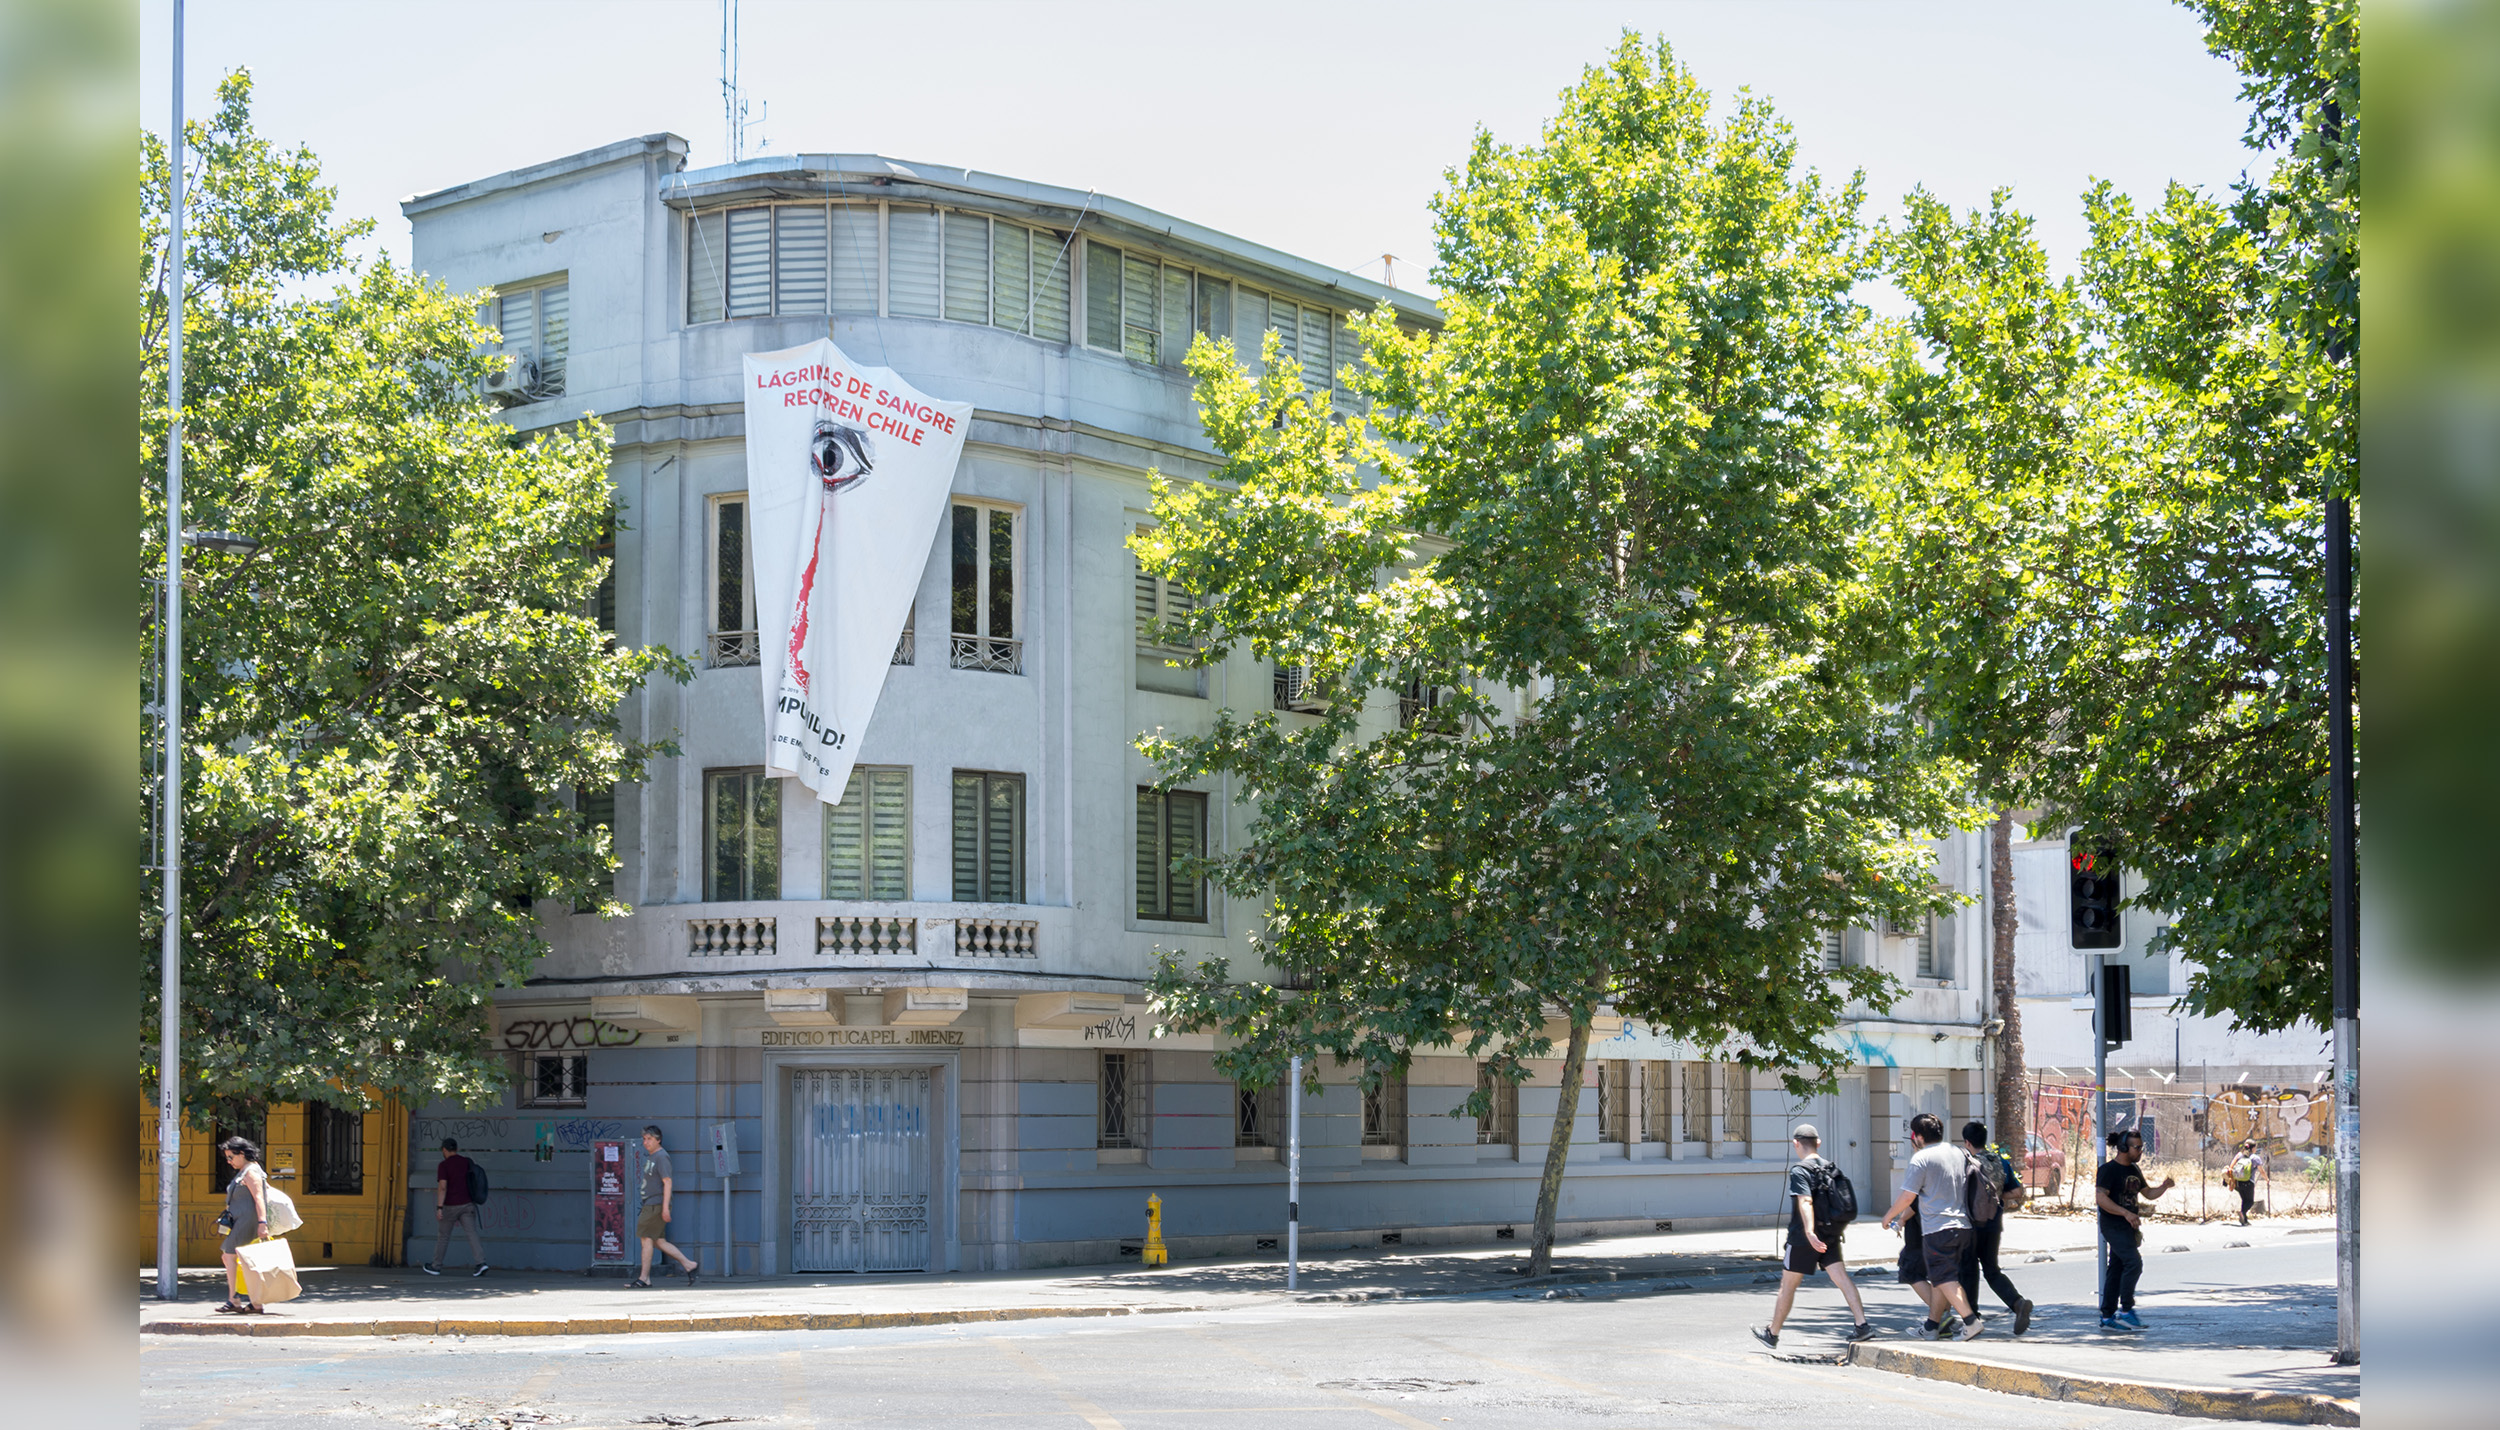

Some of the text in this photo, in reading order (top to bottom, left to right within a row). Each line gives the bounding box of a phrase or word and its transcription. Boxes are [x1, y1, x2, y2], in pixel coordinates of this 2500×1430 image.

[847, 377, 873, 400] DE
[875, 389, 956, 435] SANGRE
[867, 412, 925, 446] CHILE
[777, 735, 788, 744] DE
[761, 1030, 964, 1046] EDIFICIO TUCAPEL JIMENEZ
